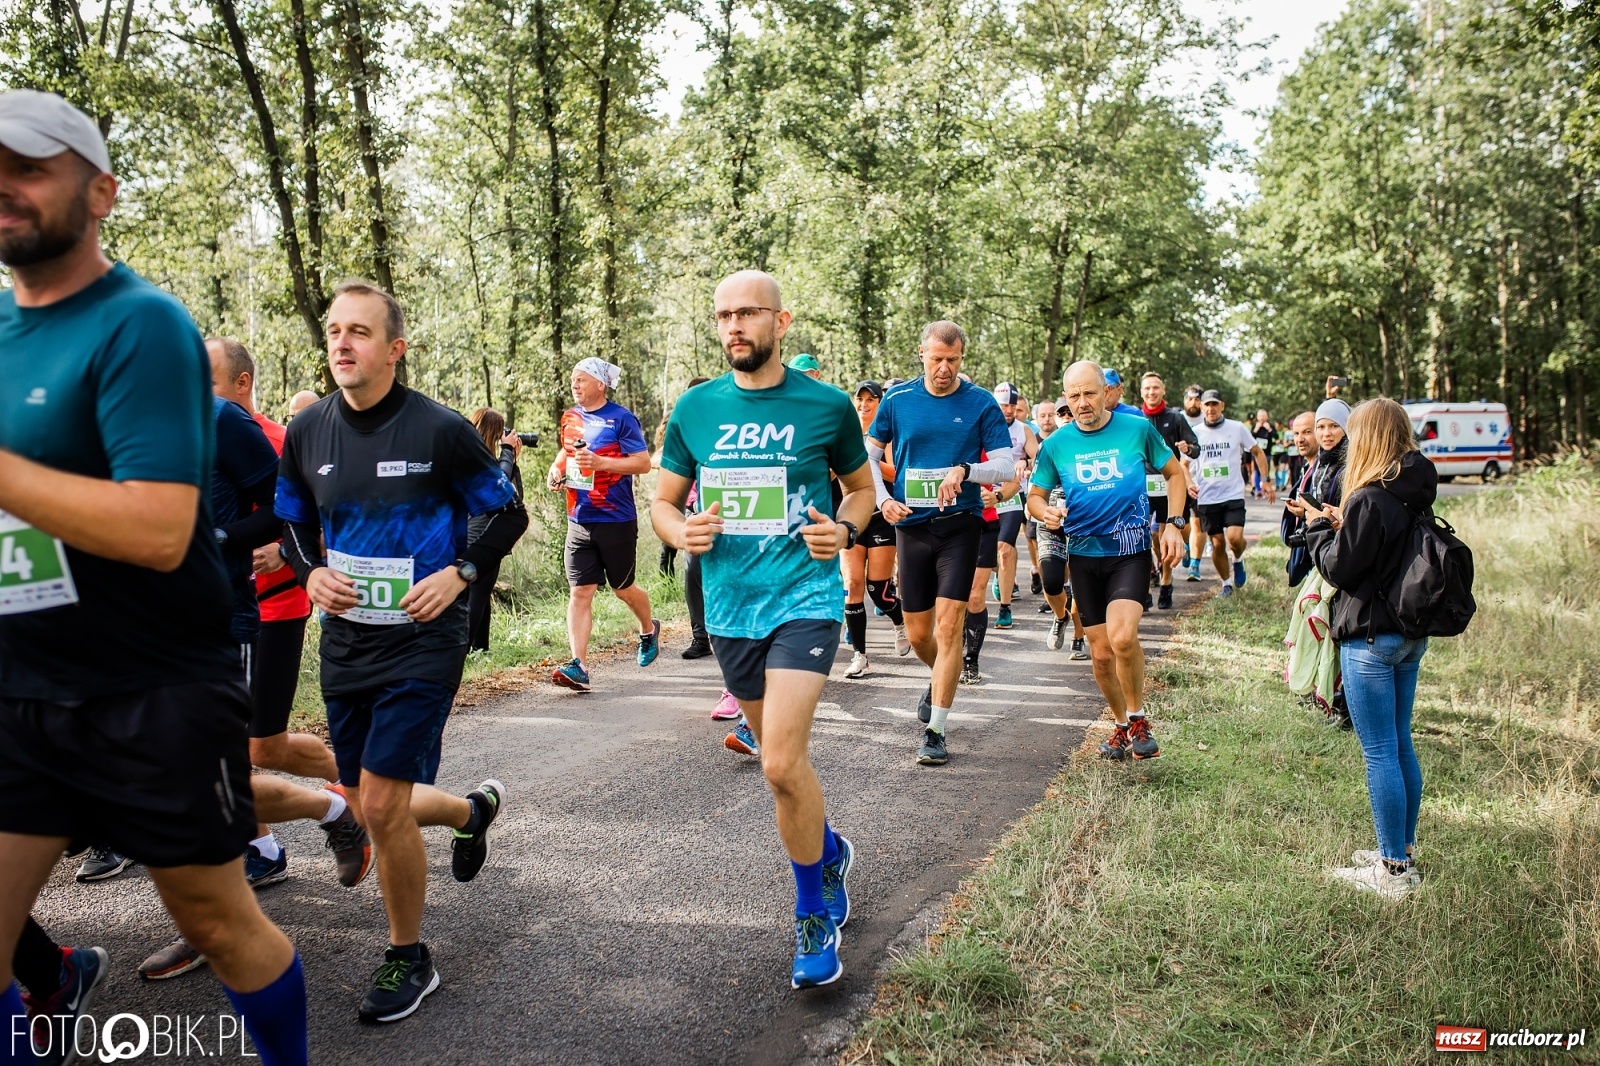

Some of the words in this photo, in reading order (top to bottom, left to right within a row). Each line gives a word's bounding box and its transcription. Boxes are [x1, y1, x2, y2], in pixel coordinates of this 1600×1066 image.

[714, 422, 795, 451] ZBM
[741, 451, 774, 461] Runners
[776, 452, 798, 462] Team
[1207, 450, 1222, 459] TEAM
[317, 464, 335, 475] 4F
[1075, 456, 1124, 484] bbl
[1209, 467, 1222, 477] 32
[921, 481, 937, 498] 11
[721, 490, 760, 518] 57
[0, 535, 34, 583] 4
[352, 578, 392, 608] 50
[809, 646, 825, 657] 4F
